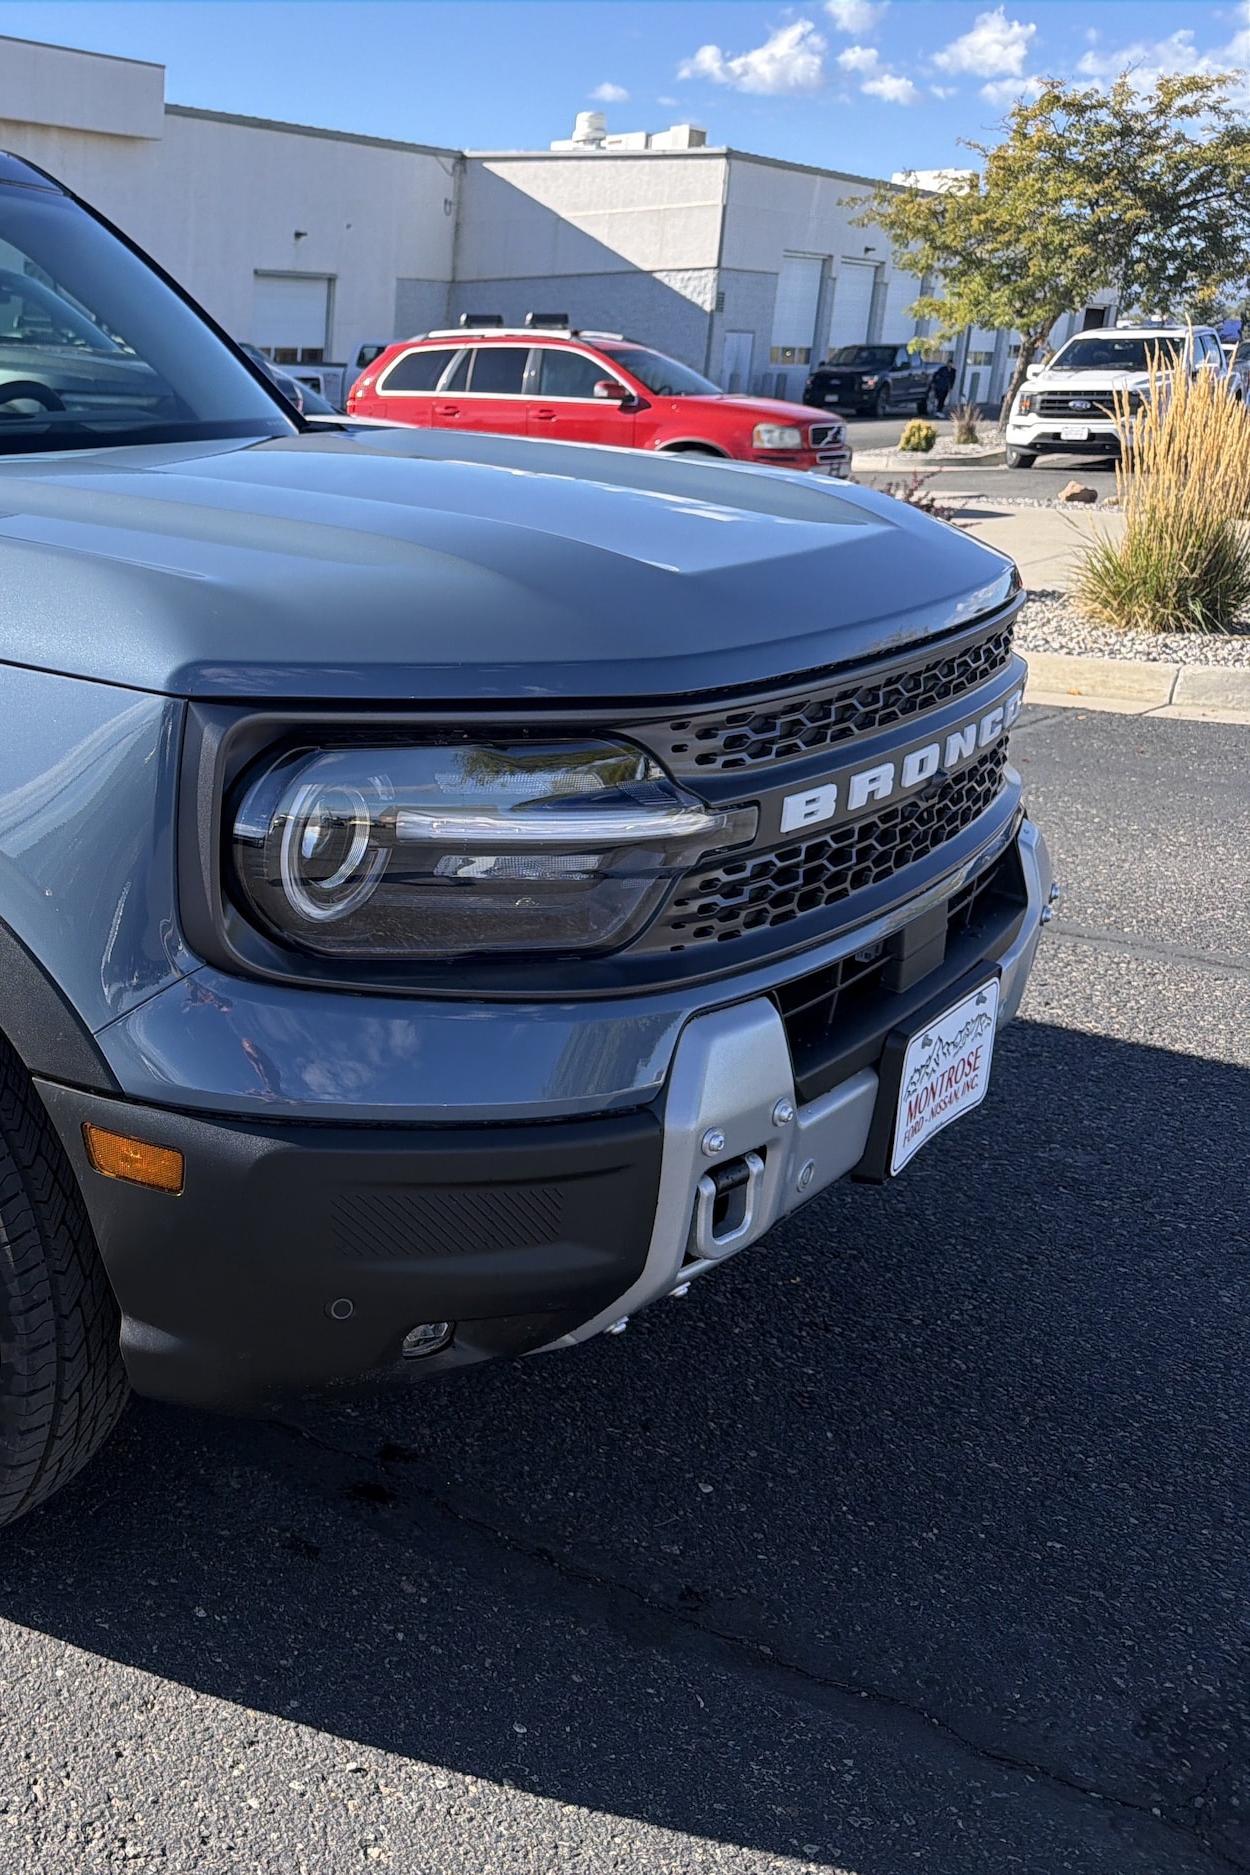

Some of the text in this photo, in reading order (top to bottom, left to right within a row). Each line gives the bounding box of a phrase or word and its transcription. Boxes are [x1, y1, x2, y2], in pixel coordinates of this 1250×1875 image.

[779, 689, 1022, 834] BRONCO
[902, 1115, 925, 1148] FORD
[960, 1073, 979, 1097] INC.
[905, 1044, 984, 1127] MONTROSE
